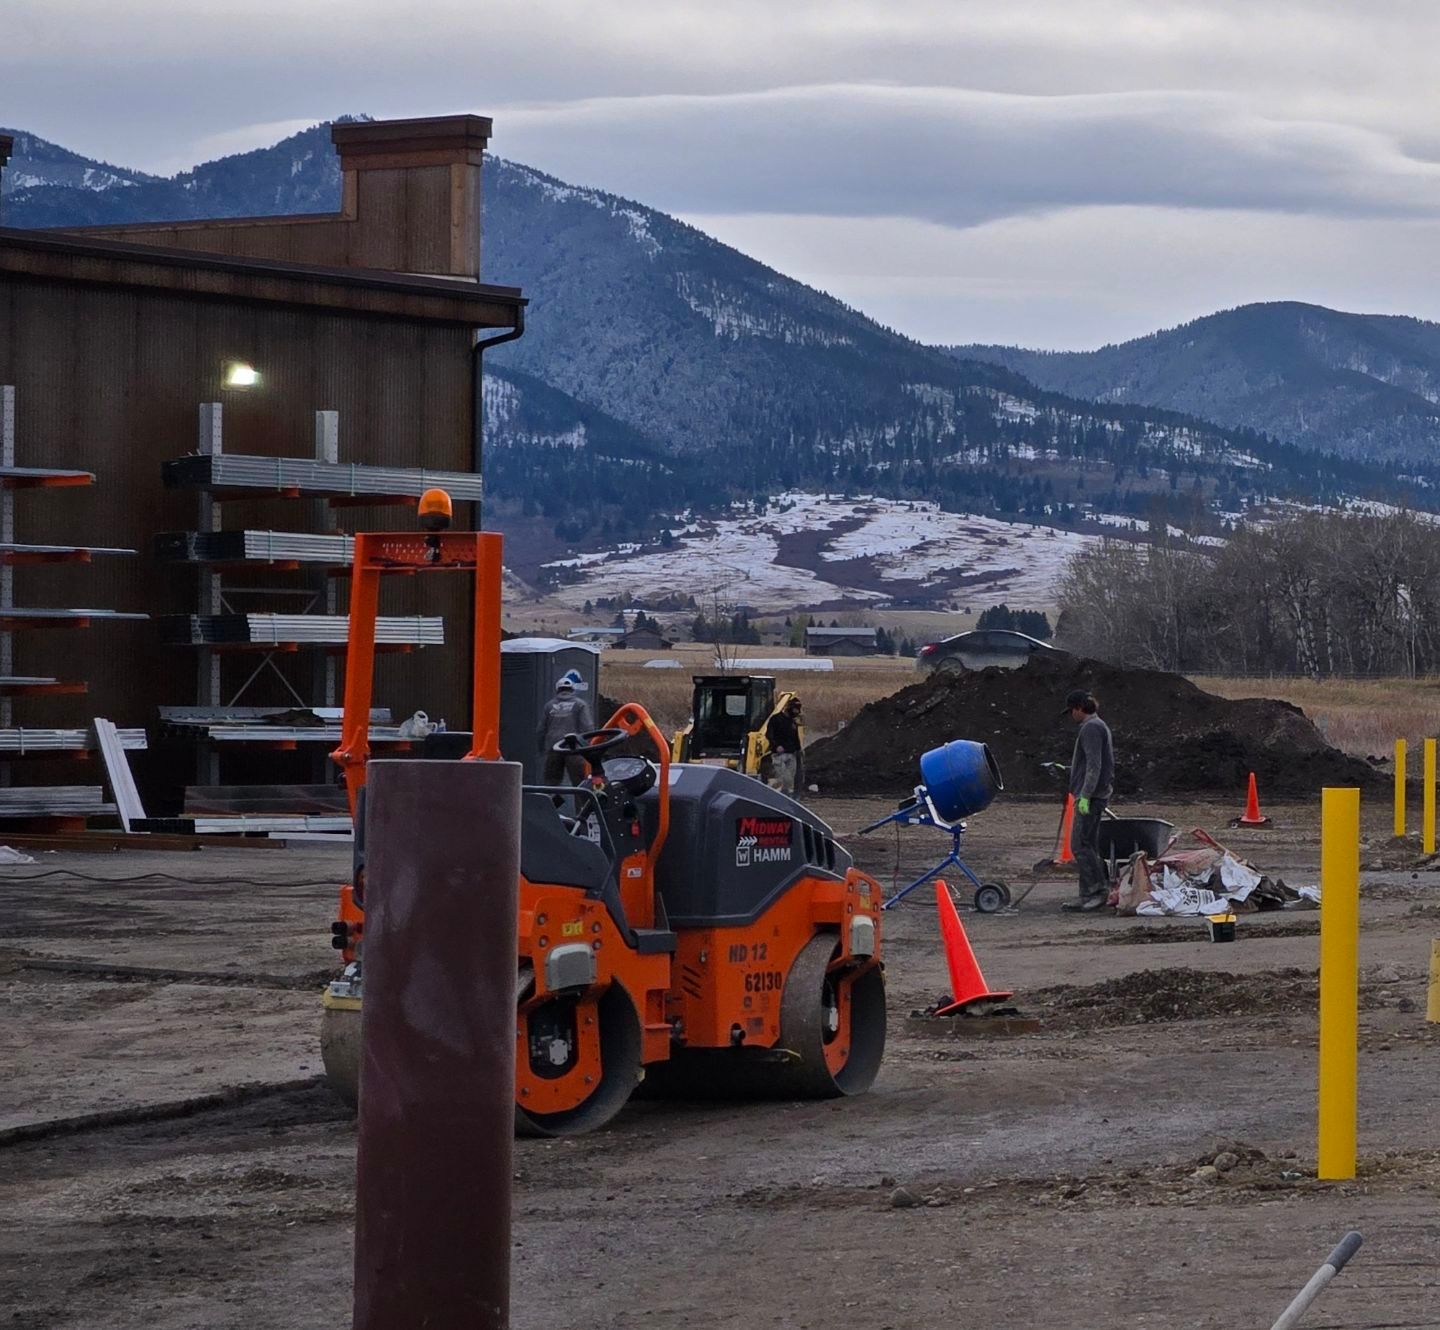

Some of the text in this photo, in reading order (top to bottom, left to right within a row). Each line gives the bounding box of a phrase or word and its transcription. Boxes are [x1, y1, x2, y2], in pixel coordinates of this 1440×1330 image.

[740, 817, 791, 834] MIDWAY
[753, 847, 791, 862] HAMM
[745, 971, 782, 992] 62130
